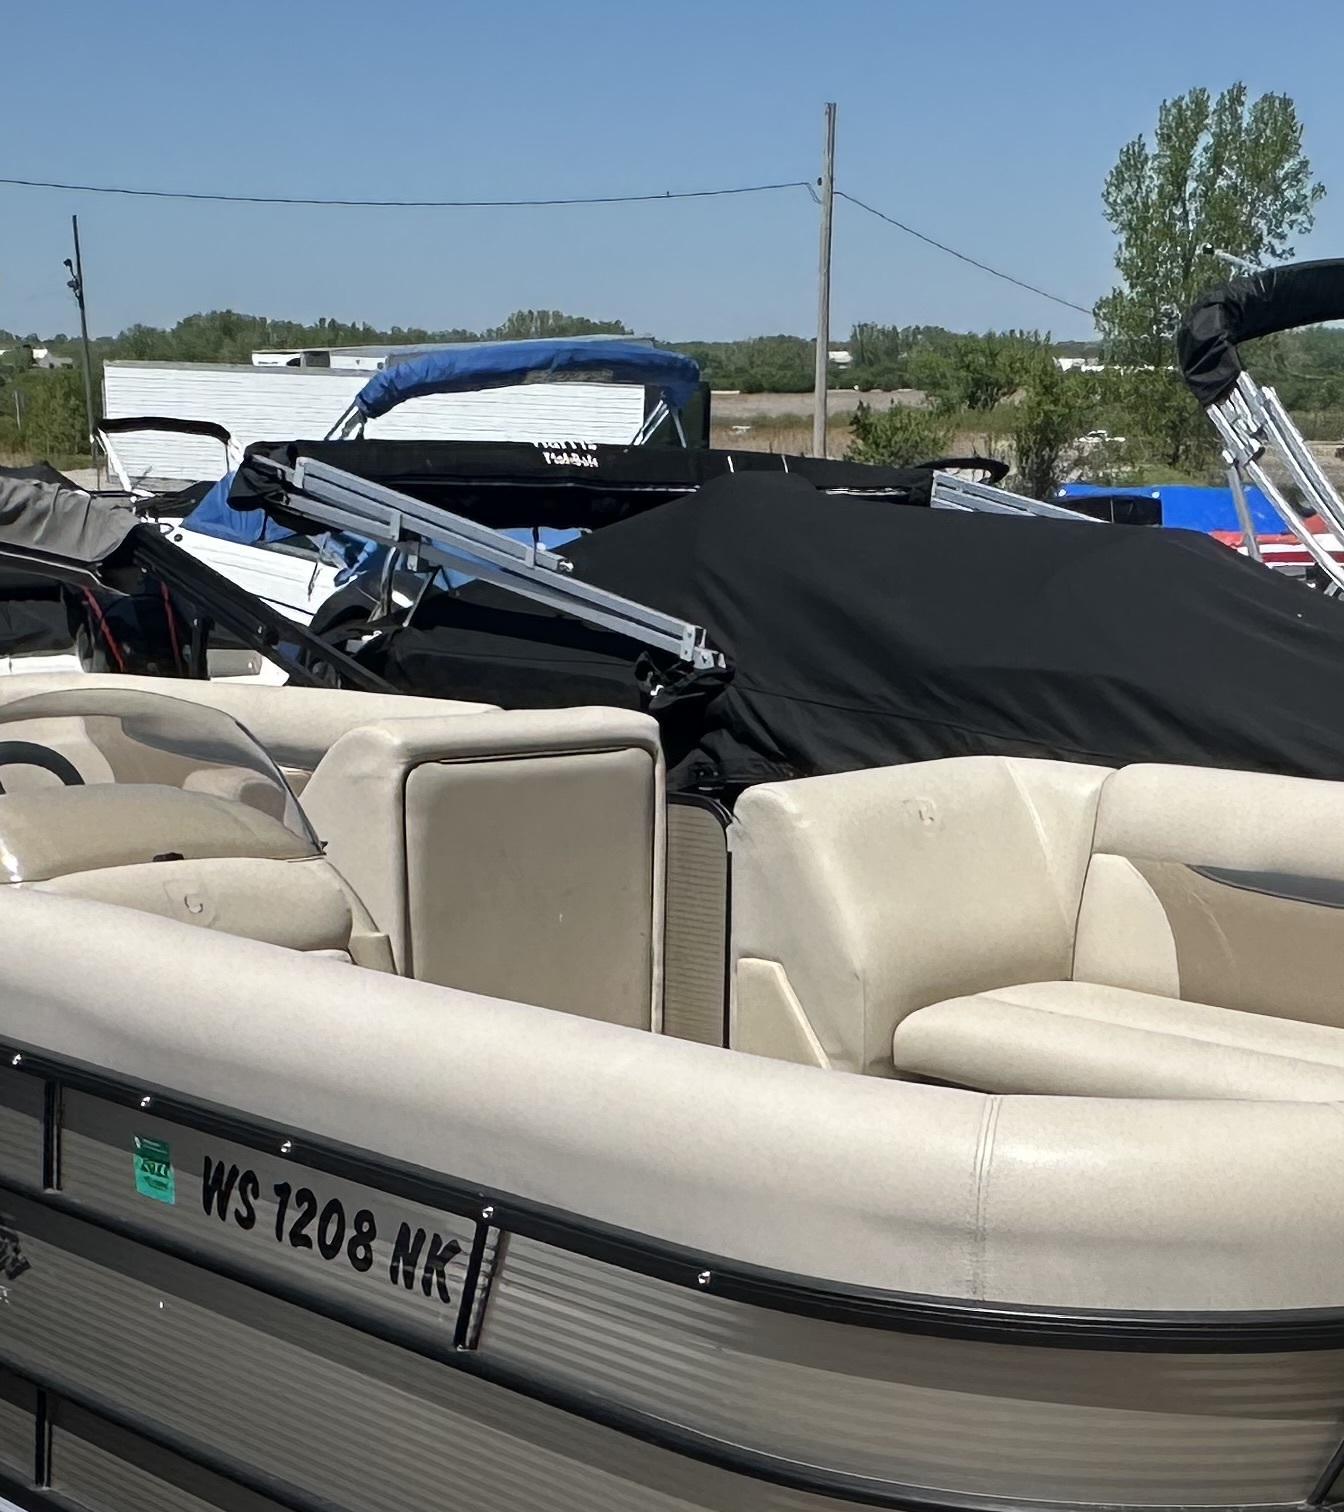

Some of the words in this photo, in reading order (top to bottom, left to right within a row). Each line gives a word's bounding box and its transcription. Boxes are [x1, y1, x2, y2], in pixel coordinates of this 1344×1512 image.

[202, 1155, 260, 1231] WS
[273, 1181, 377, 1273] 1208
[389, 1221, 463, 1305] NK
